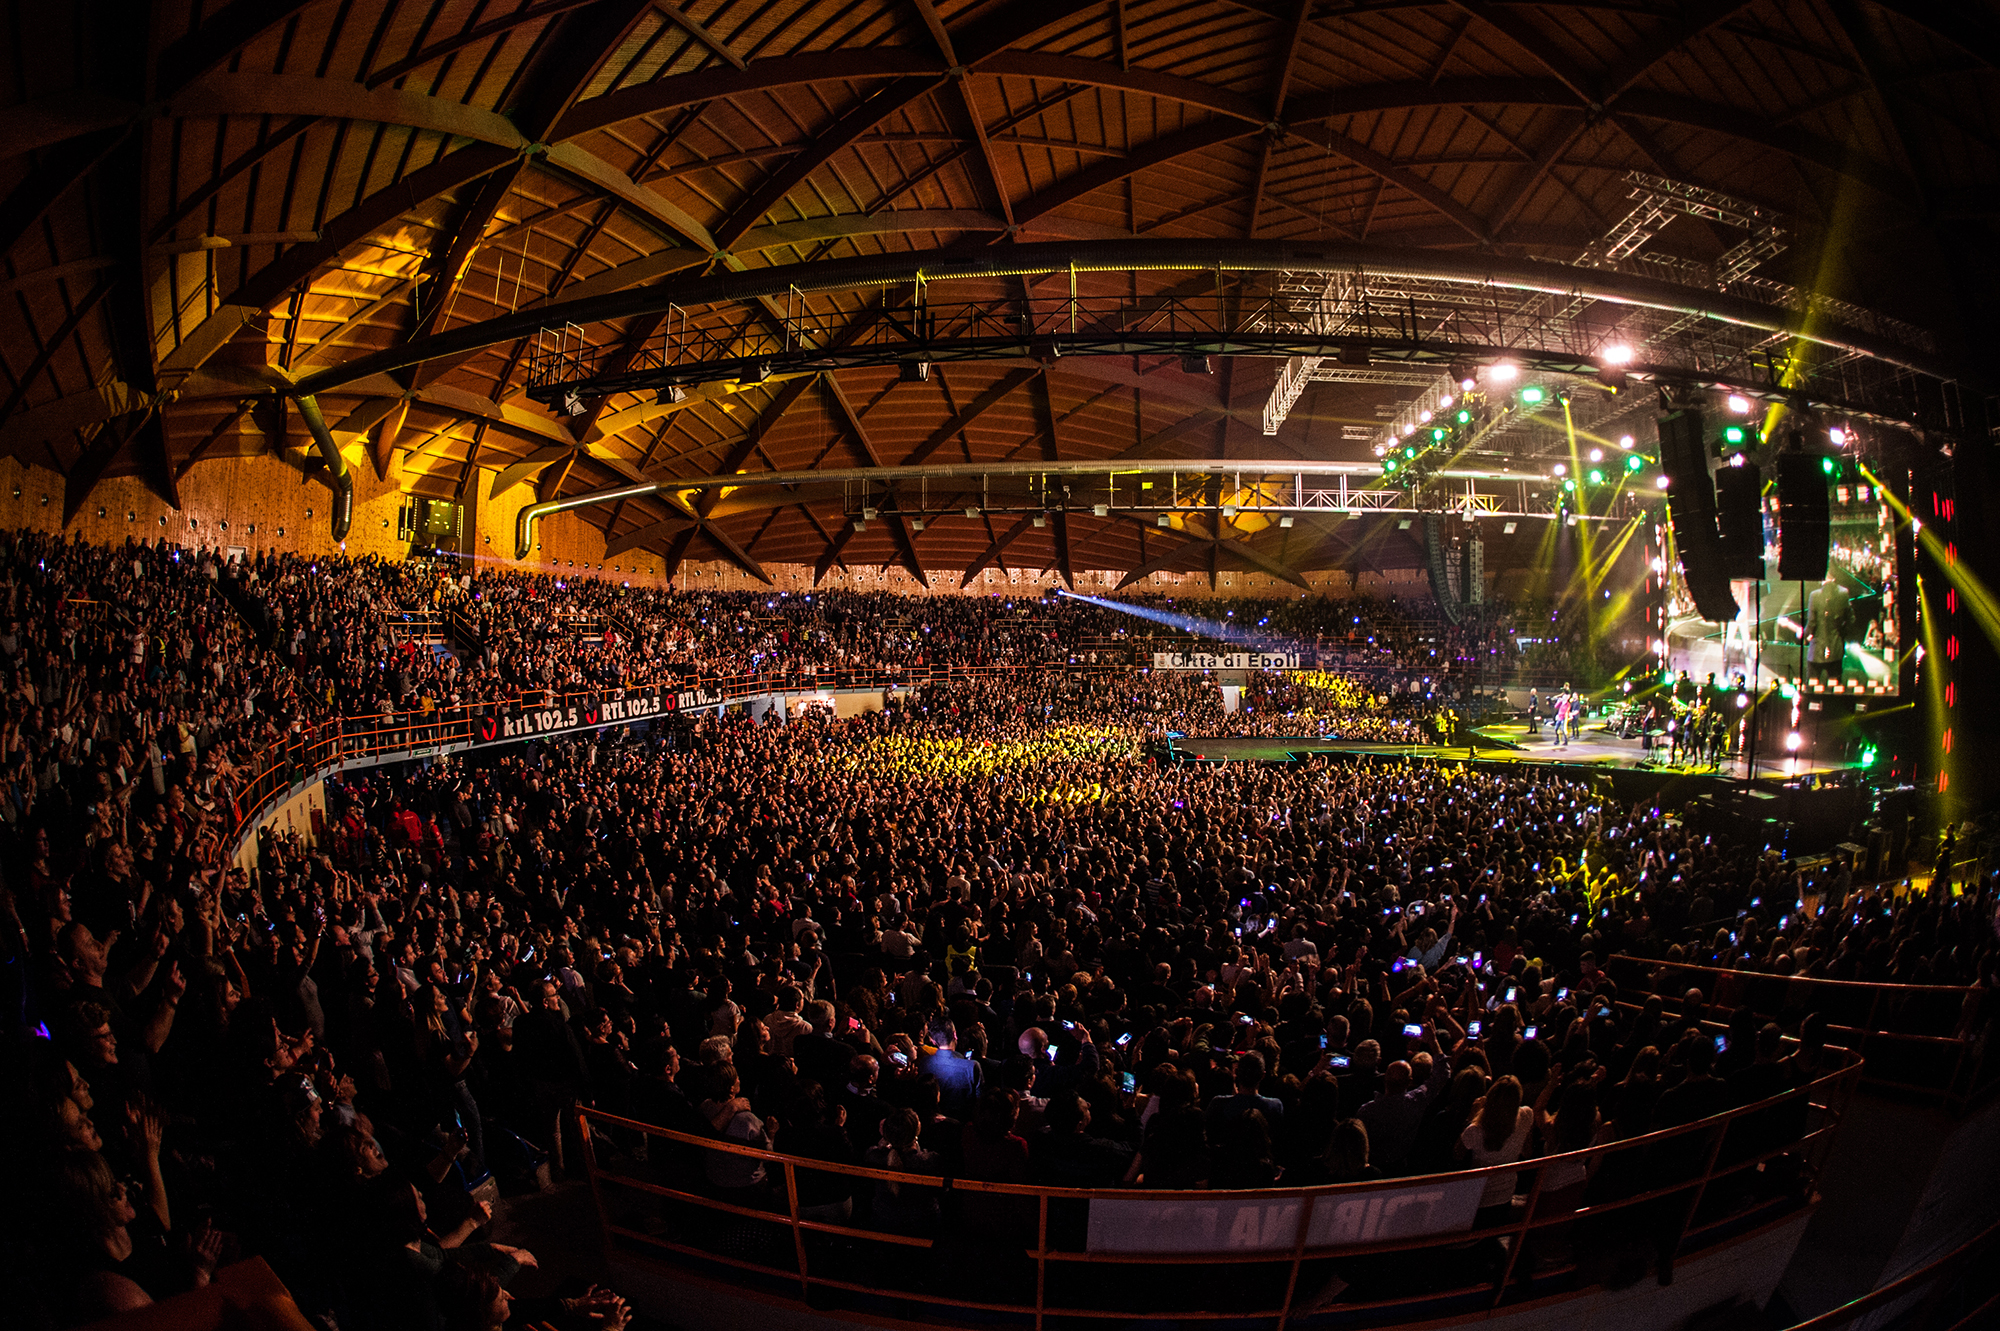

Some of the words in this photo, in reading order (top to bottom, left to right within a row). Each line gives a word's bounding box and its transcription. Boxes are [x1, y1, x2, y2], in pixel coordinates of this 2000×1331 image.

[1223, 654, 1241, 668] di
[1248, 654, 1297, 668] Eboli
[601, 701, 625, 721] RTL
[626, 696, 661, 717] 102.5
[678, 691, 696, 709] RTL
[534, 707, 579, 732] 102.5
